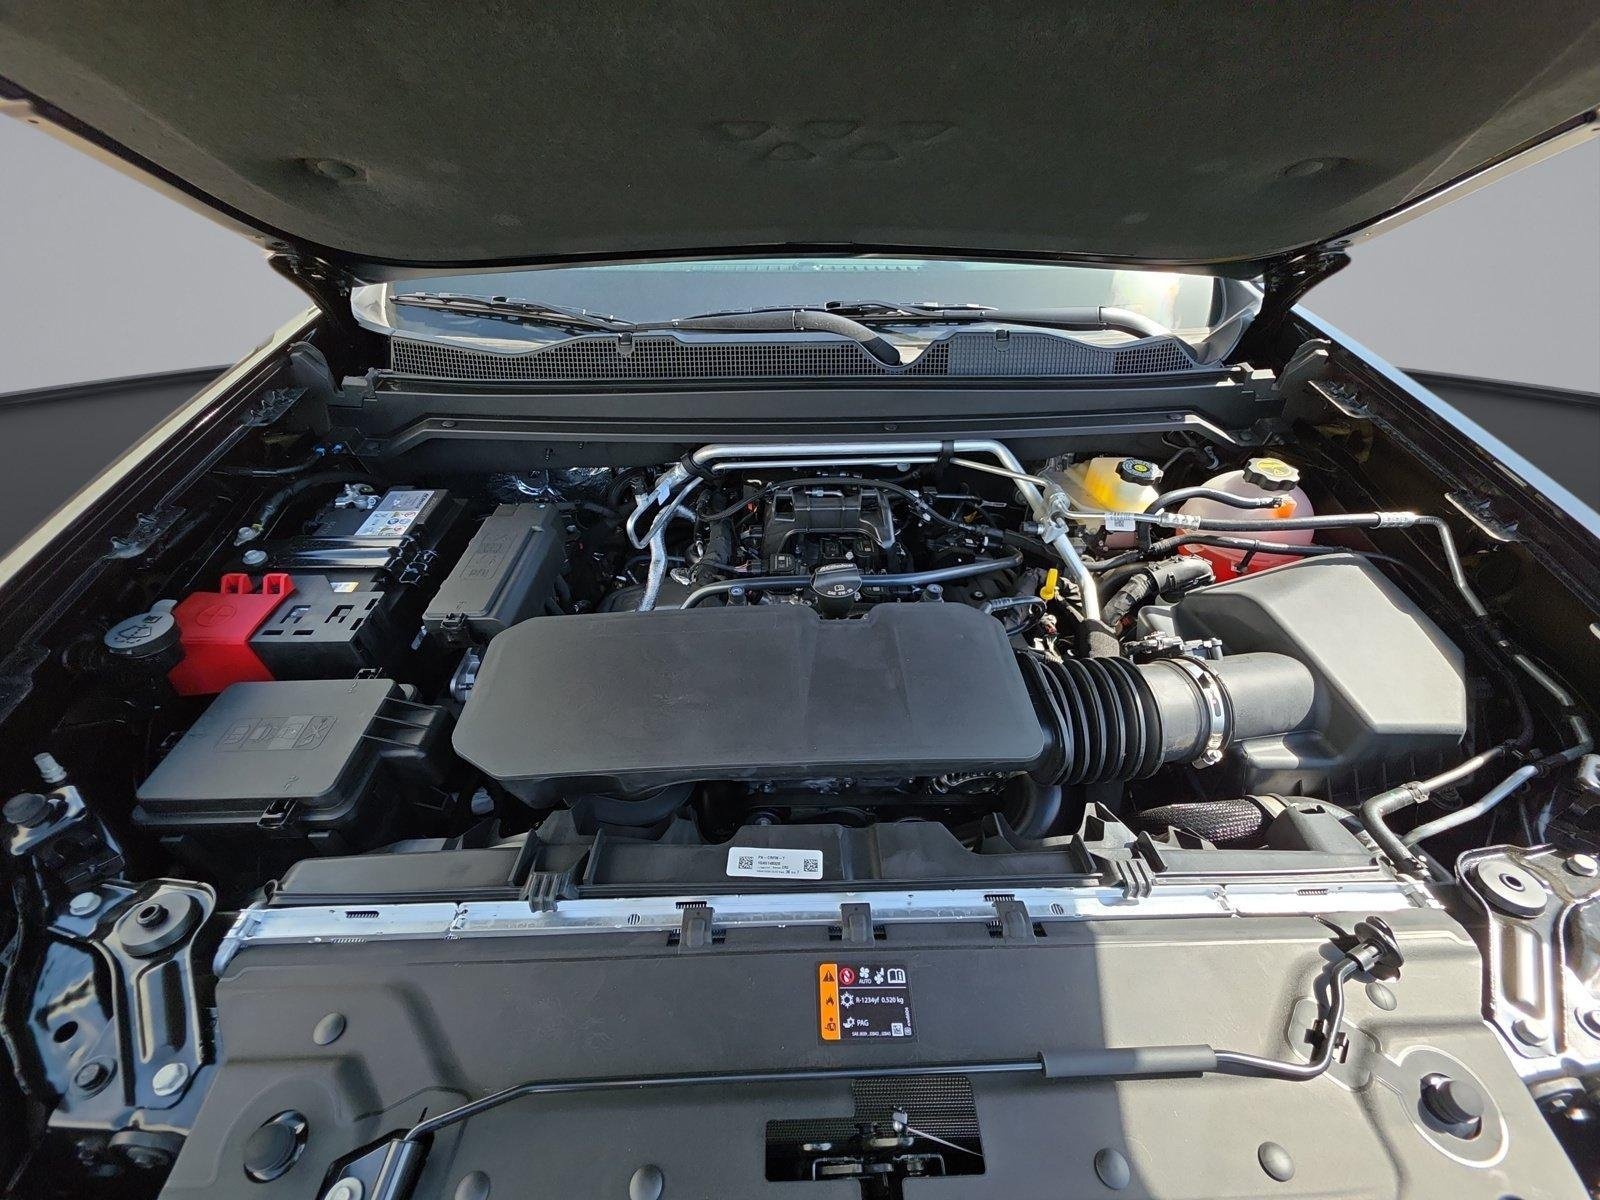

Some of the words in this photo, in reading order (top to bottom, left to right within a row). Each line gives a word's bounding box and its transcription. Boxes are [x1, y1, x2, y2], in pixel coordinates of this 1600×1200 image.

[855, 996, 880, 1005] R-1234yf
[880, 996, 896, 1004] 0.520
[896, 996, 904, 1005] kg
[856, 1019, 870, 1027] PAG
